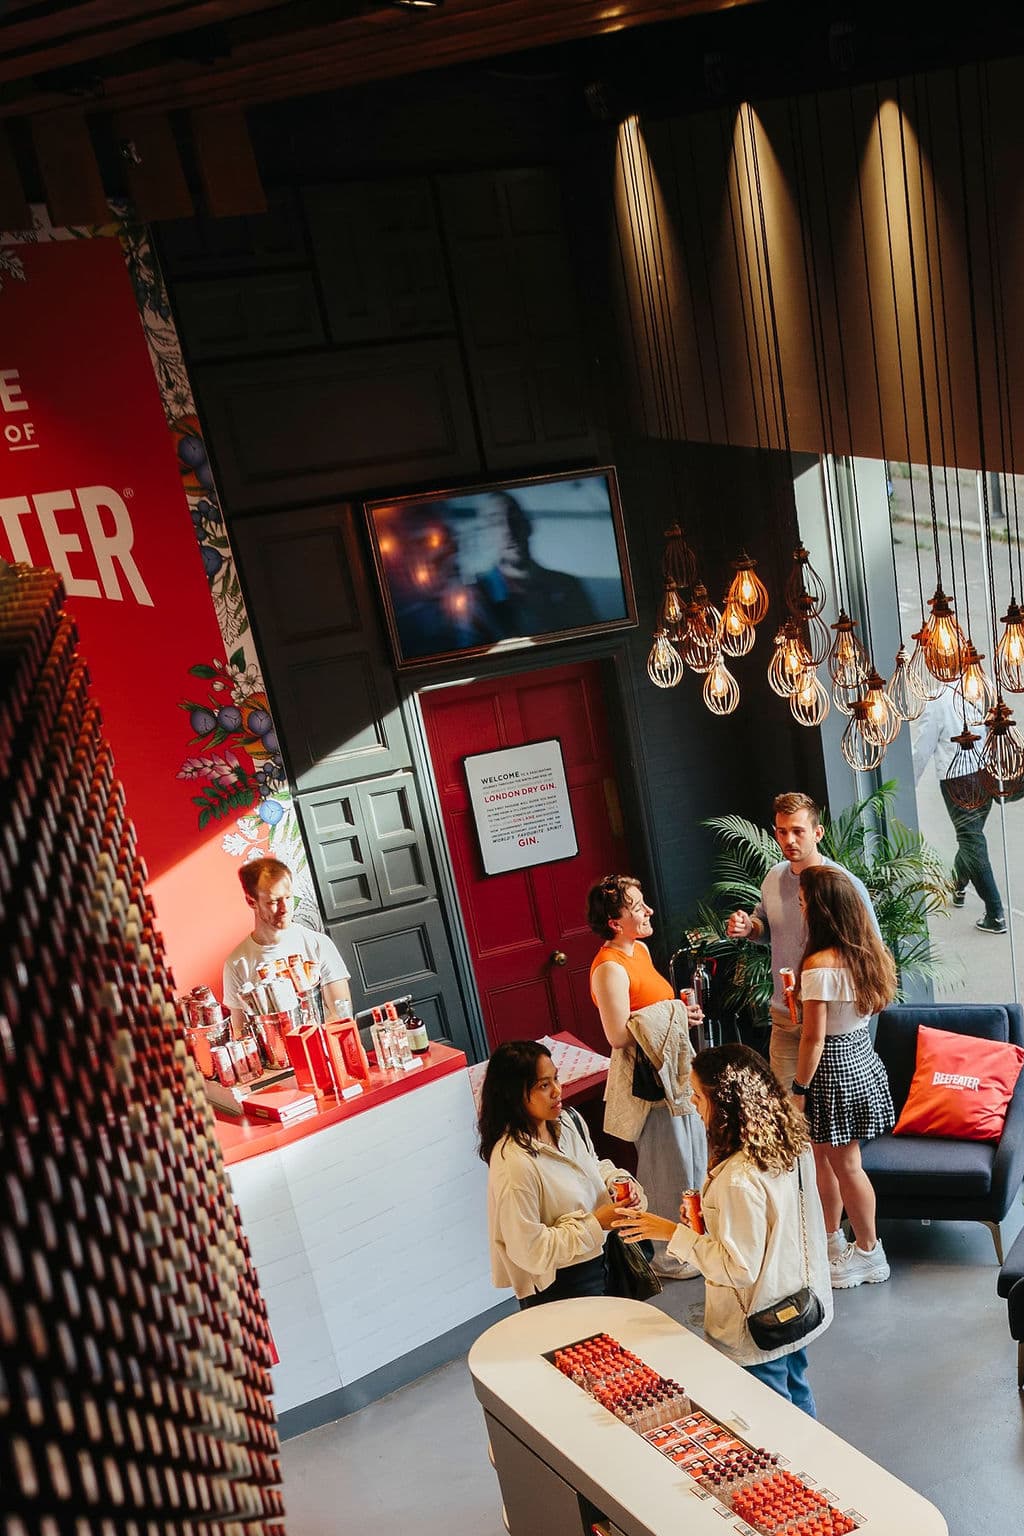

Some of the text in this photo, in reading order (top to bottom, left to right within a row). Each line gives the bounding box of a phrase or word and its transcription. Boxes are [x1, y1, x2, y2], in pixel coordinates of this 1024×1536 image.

[4, 423, 36, 443] OF
[481, 771, 519, 784] WELCOME
[484, 790, 520, 803] LONDON
[521, 785, 538, 796] DRY
[931, 1071, 980, 1093] BEEFEATER
